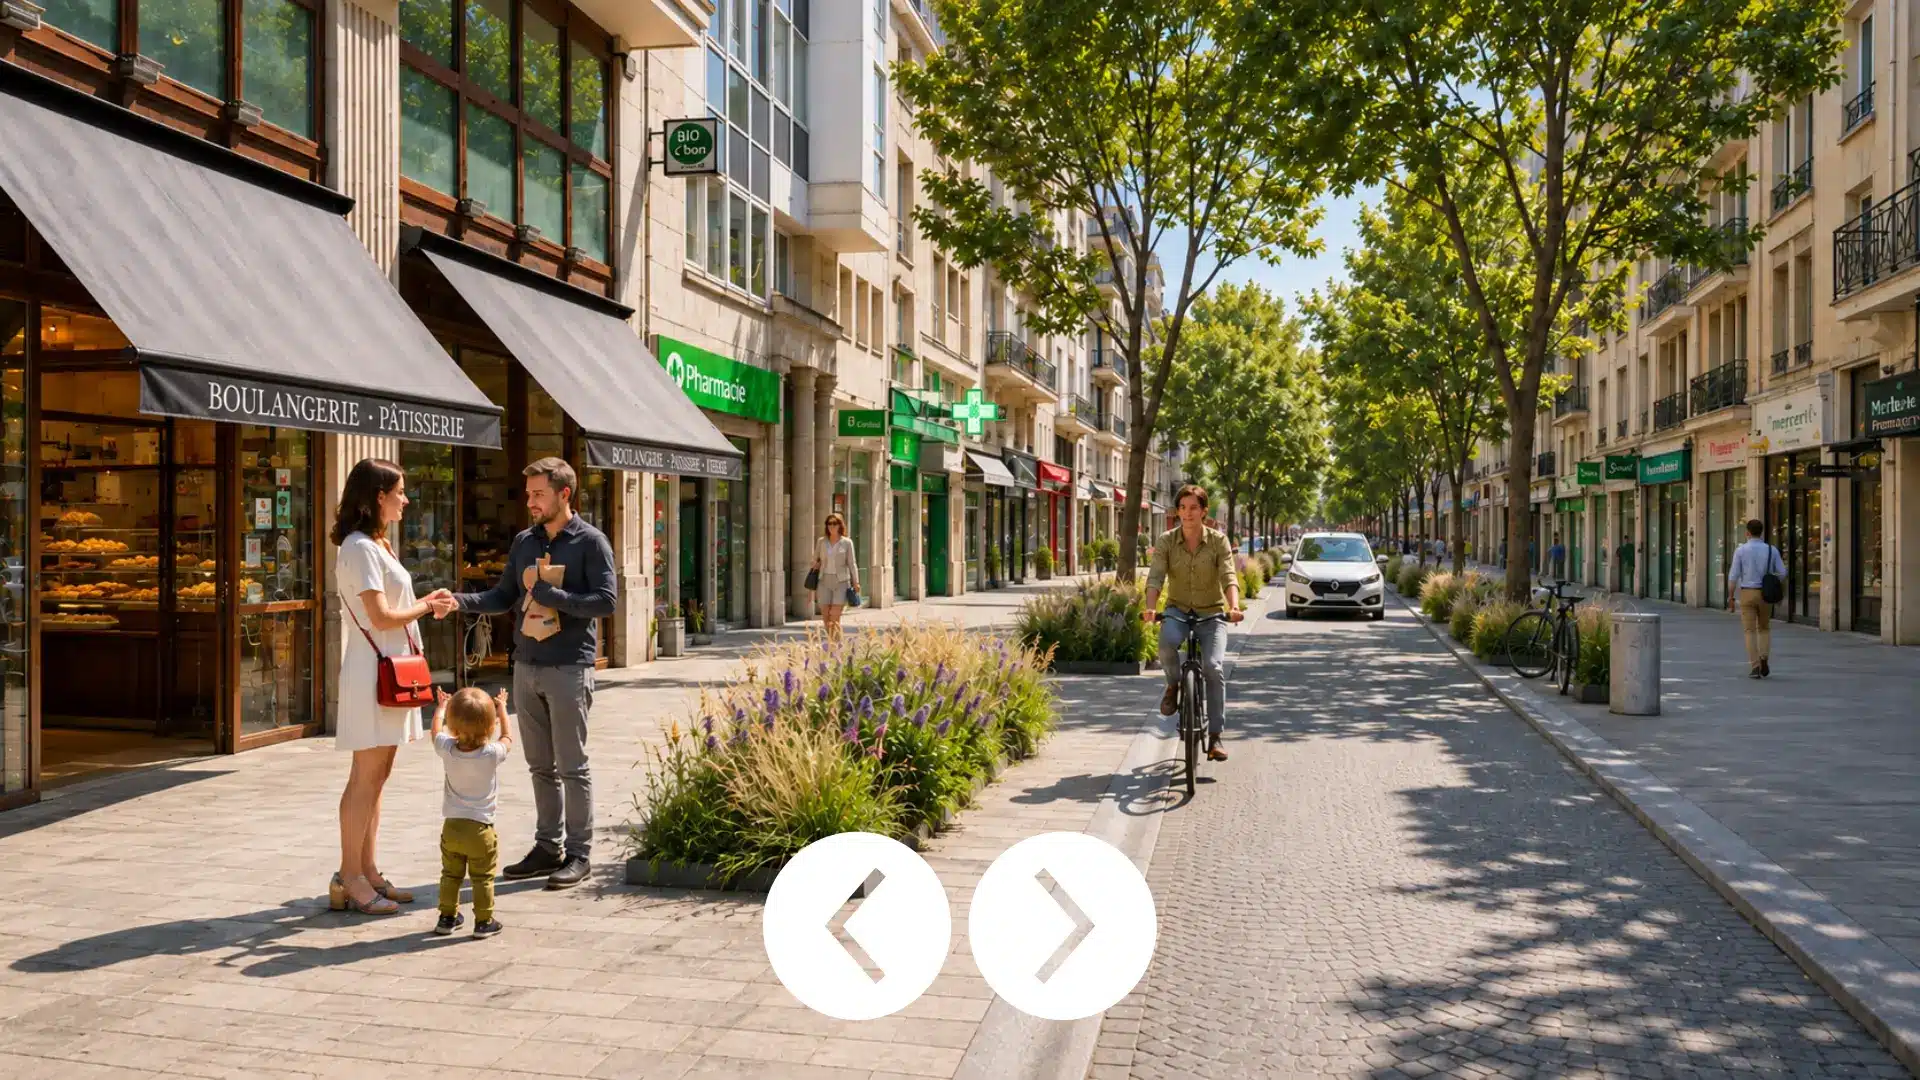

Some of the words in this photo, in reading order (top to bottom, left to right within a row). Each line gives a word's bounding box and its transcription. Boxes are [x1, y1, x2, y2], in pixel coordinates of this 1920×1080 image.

[677, 129, 700, 142] BIO
[683, 143, 706, 155] bon
[686, 363, 746, 403] Pharmacie
[208, 381, 360, 426] BOULANGERIE
[378, 402, 465, 439] PÂTISSERIE
